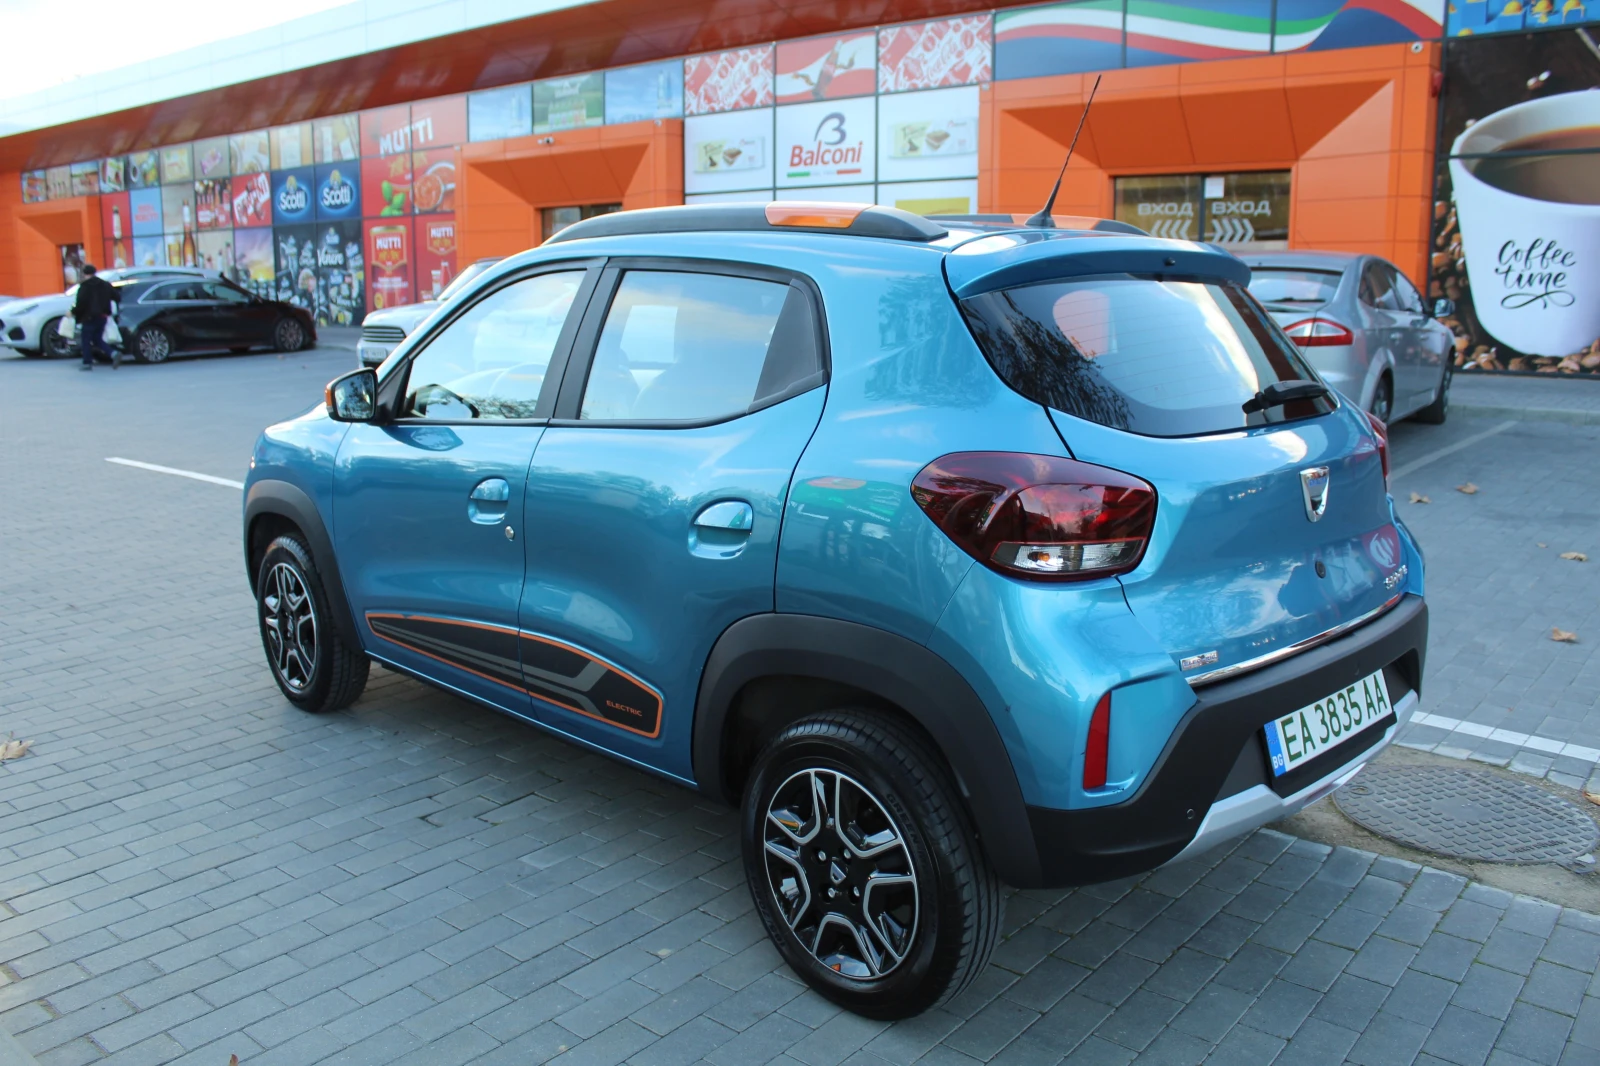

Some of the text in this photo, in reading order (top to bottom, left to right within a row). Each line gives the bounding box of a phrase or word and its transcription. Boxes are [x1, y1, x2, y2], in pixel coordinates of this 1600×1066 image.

[379, 117, 434, 160] MUTTI
[790, 139, 863, 168] Balconi
[280, 190, 306, 210] Scotti
[322, 184, 351, 206] Scotti
[1137, 202, 1194, 216] ВХОД
[1211, 200, 1271, 217] ВХОД
[430, 226, 454, 239] MUTTI
[376, 236, 402, 250] MUTTI
[1498, 238, 1577, 270] Coffee
[1495, 265, 1568, 295] time
[606, 700, 643, 717] ELECTRIC
[1280, 674, 1388, 762] EA 3835 AA
[1272, 754, 1284, 769] BG
